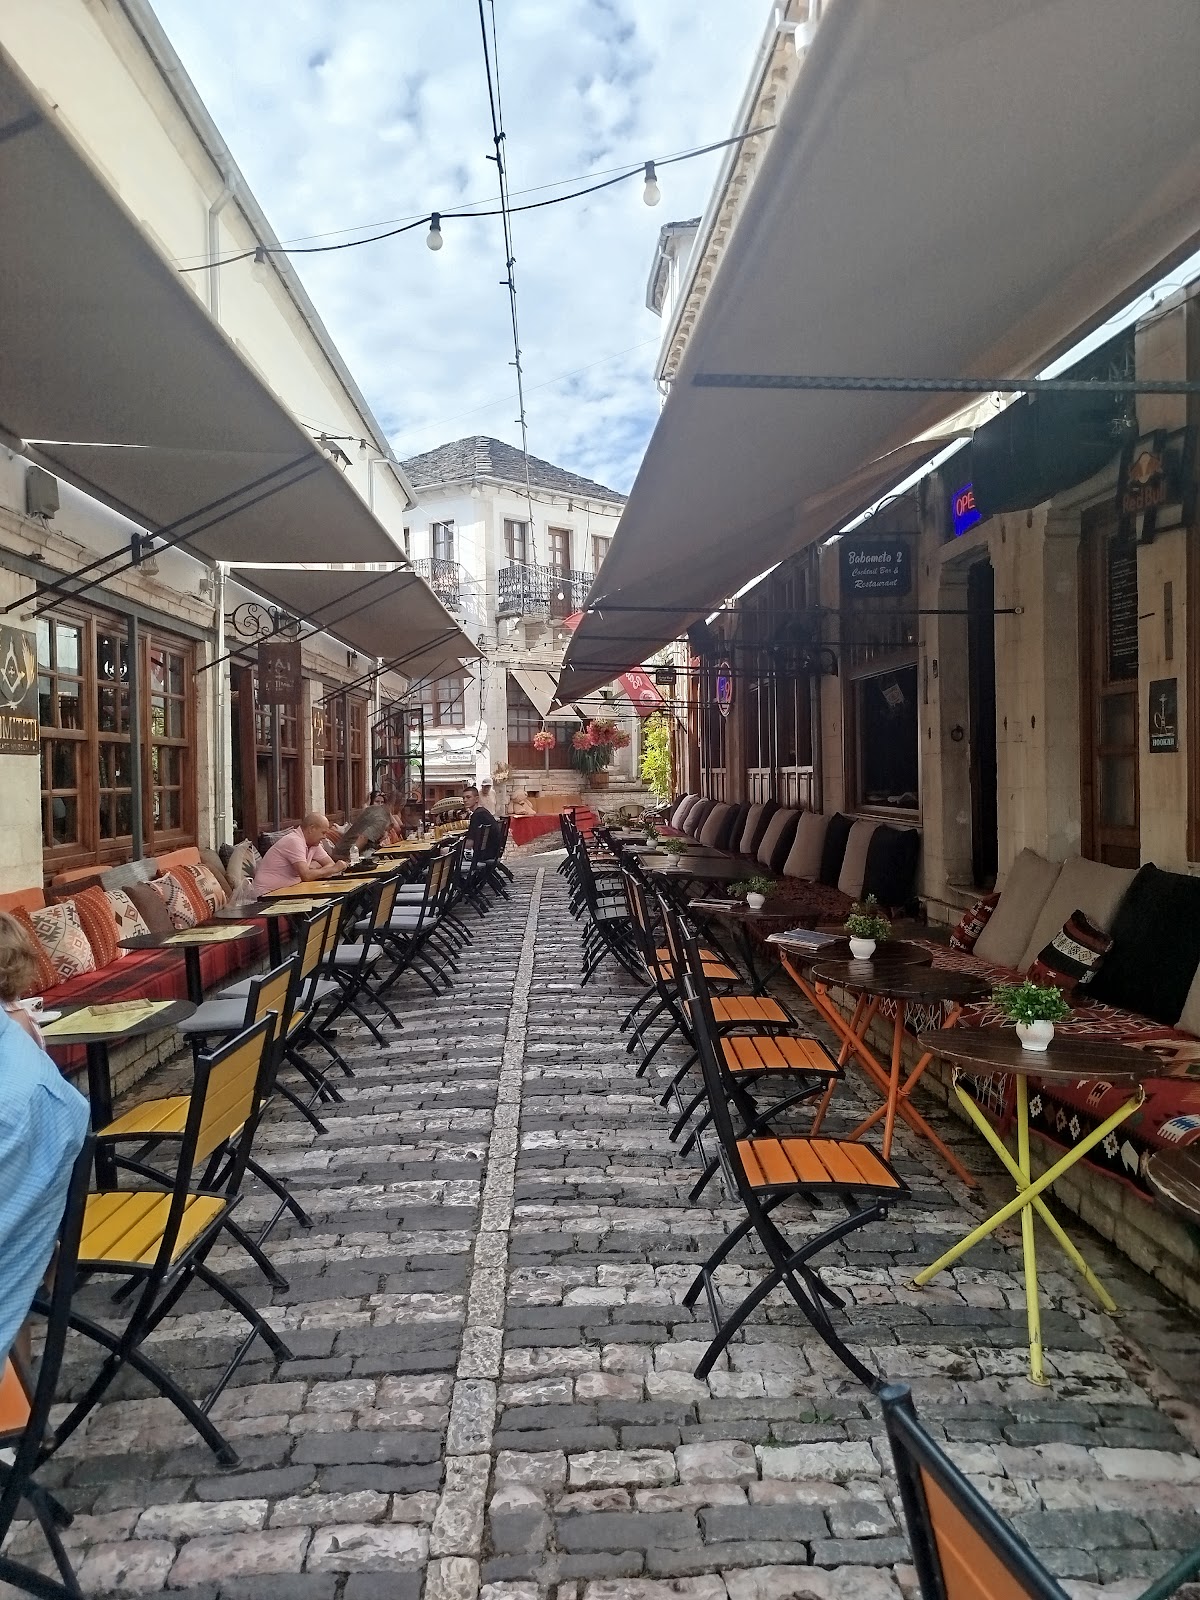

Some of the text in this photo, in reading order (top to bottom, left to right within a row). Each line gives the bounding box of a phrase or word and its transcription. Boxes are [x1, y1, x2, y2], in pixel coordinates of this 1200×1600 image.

[956, 491, 976, 516] OPE
[848, 551, 902, 564] Babameto 2
[851, 566, 899, 577] Cocktail Bar &
[854, 579, 897, 588] Restaurant
[0, 715, 37, 741] MITETI
[1152, 738, 1175, 747] HOOKAH
